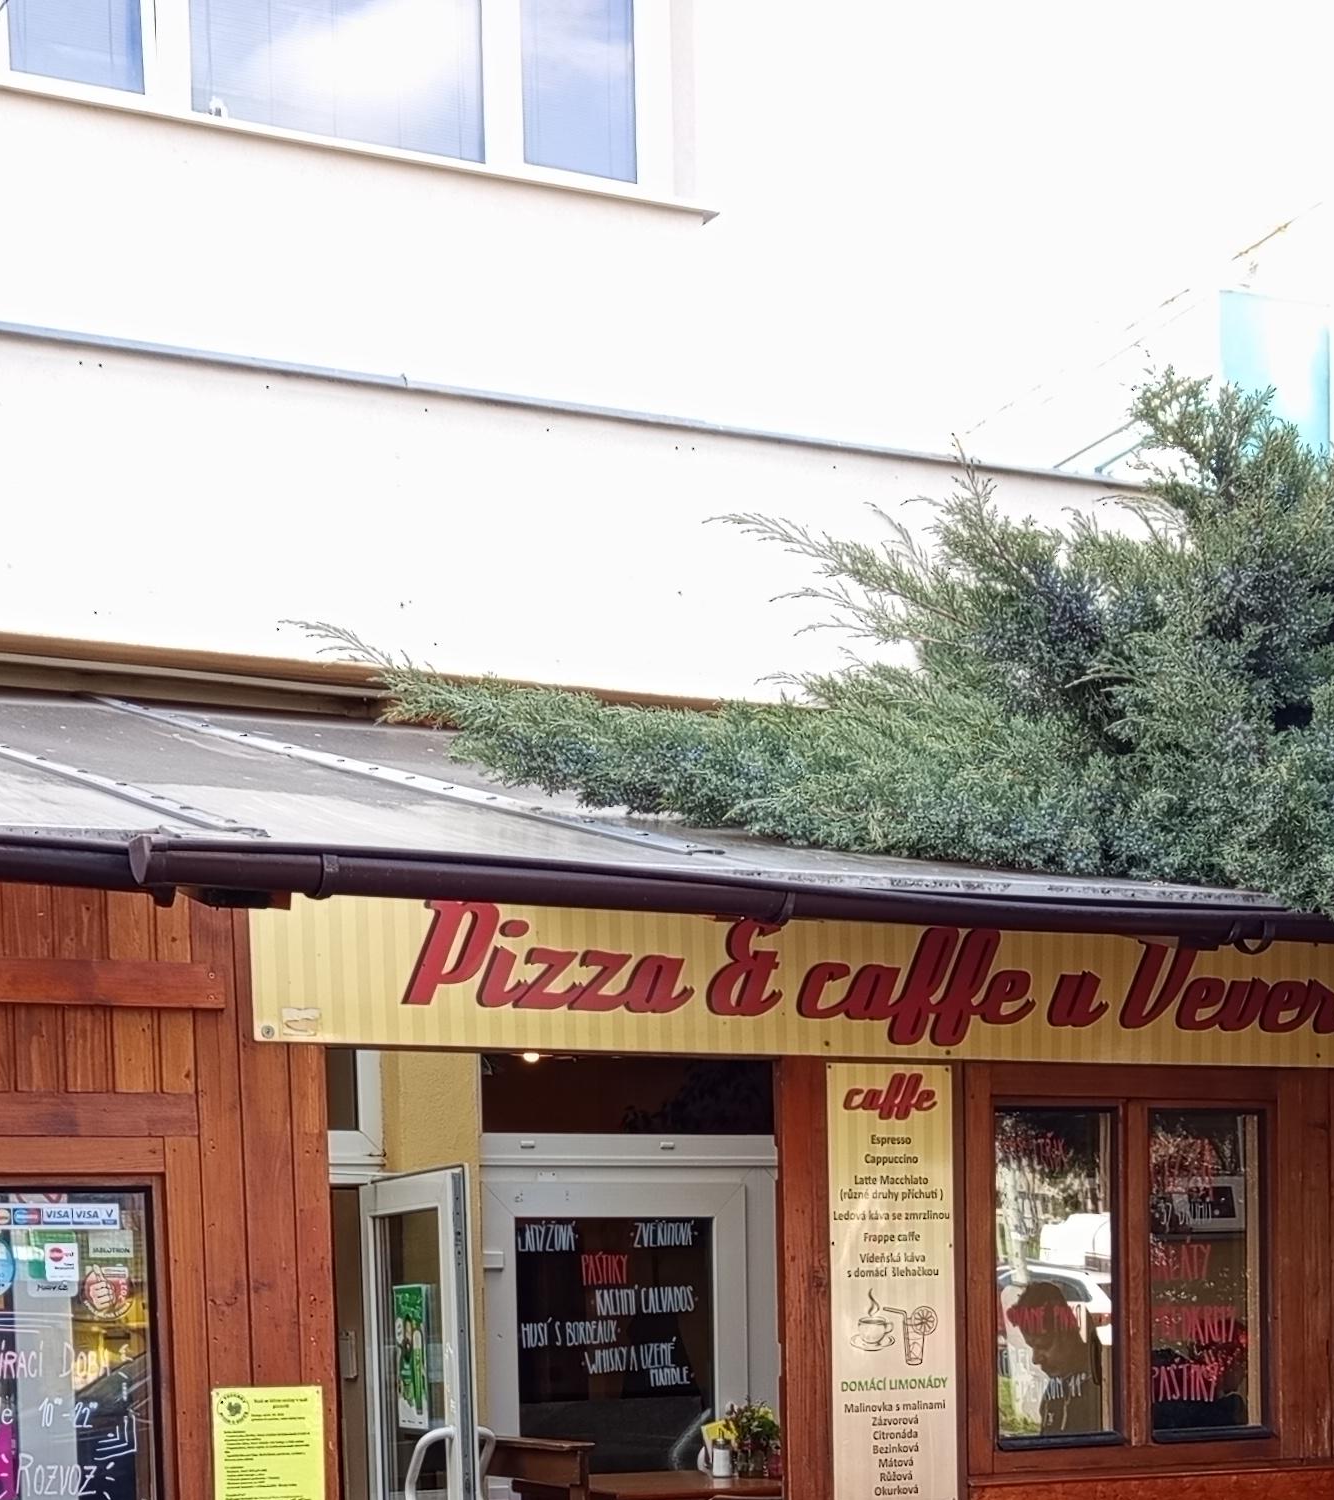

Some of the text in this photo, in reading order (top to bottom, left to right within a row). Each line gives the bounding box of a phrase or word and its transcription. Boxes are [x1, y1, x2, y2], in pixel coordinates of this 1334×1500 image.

[402, 900, 695, 1013] Pizza
[706, 918, 783, 1016] &
[796, 926, 1035, 1046] caffe
[1047, 970, 1109, 1029] u
[843, 1072, 938, 1120] caffe
[870, 1134, 912, 1146] Espresso
[864, 1153, 919, 1165] Cappuccino
[854, 1174, 929, 1185] Latte Macchiato
[872, 1188, 899, 1201] druhy
[46, 1209, 69, 1219] VISA
[76, 1210, 99, 1219] VISA
[833, 1209, 950, 1221] Ledová káva se zmrzlinou
[863, 1231, 921, 1244] Frappe caffe
[859, 1252, 926, 1264] Vídeňská káva
[854, 1266, 888, 1277] domácí
[891, 1265, 939, 1277] šlehačkou
[641, 1285, 695, 1314] CALVADOS
[555, 1320, 562, 1346] S
[566, 1319, 617, 1346] BORDEAUX
[59, 1341, 111, 1378] DOBA
[841, 1375, 949, 1392] DOMÁCÍ LIMONÁDY
[844, 1402, 893, 1413] Malinovka
[902, 1400, 946, 1411] malinami
[871, 1415, 919, 1426] Zázvorová
[873, 1429, 918, 1440] Citronáda
[872, 1443, 919, 1454] Bezinková
[878, 1457, 914, 1468] Mátová
[16, 1453, 97, 1497] ROZVOZ
[880, 1470, 913, 1482] Růžová
[874, 1485, 919, 1497] Okurková
